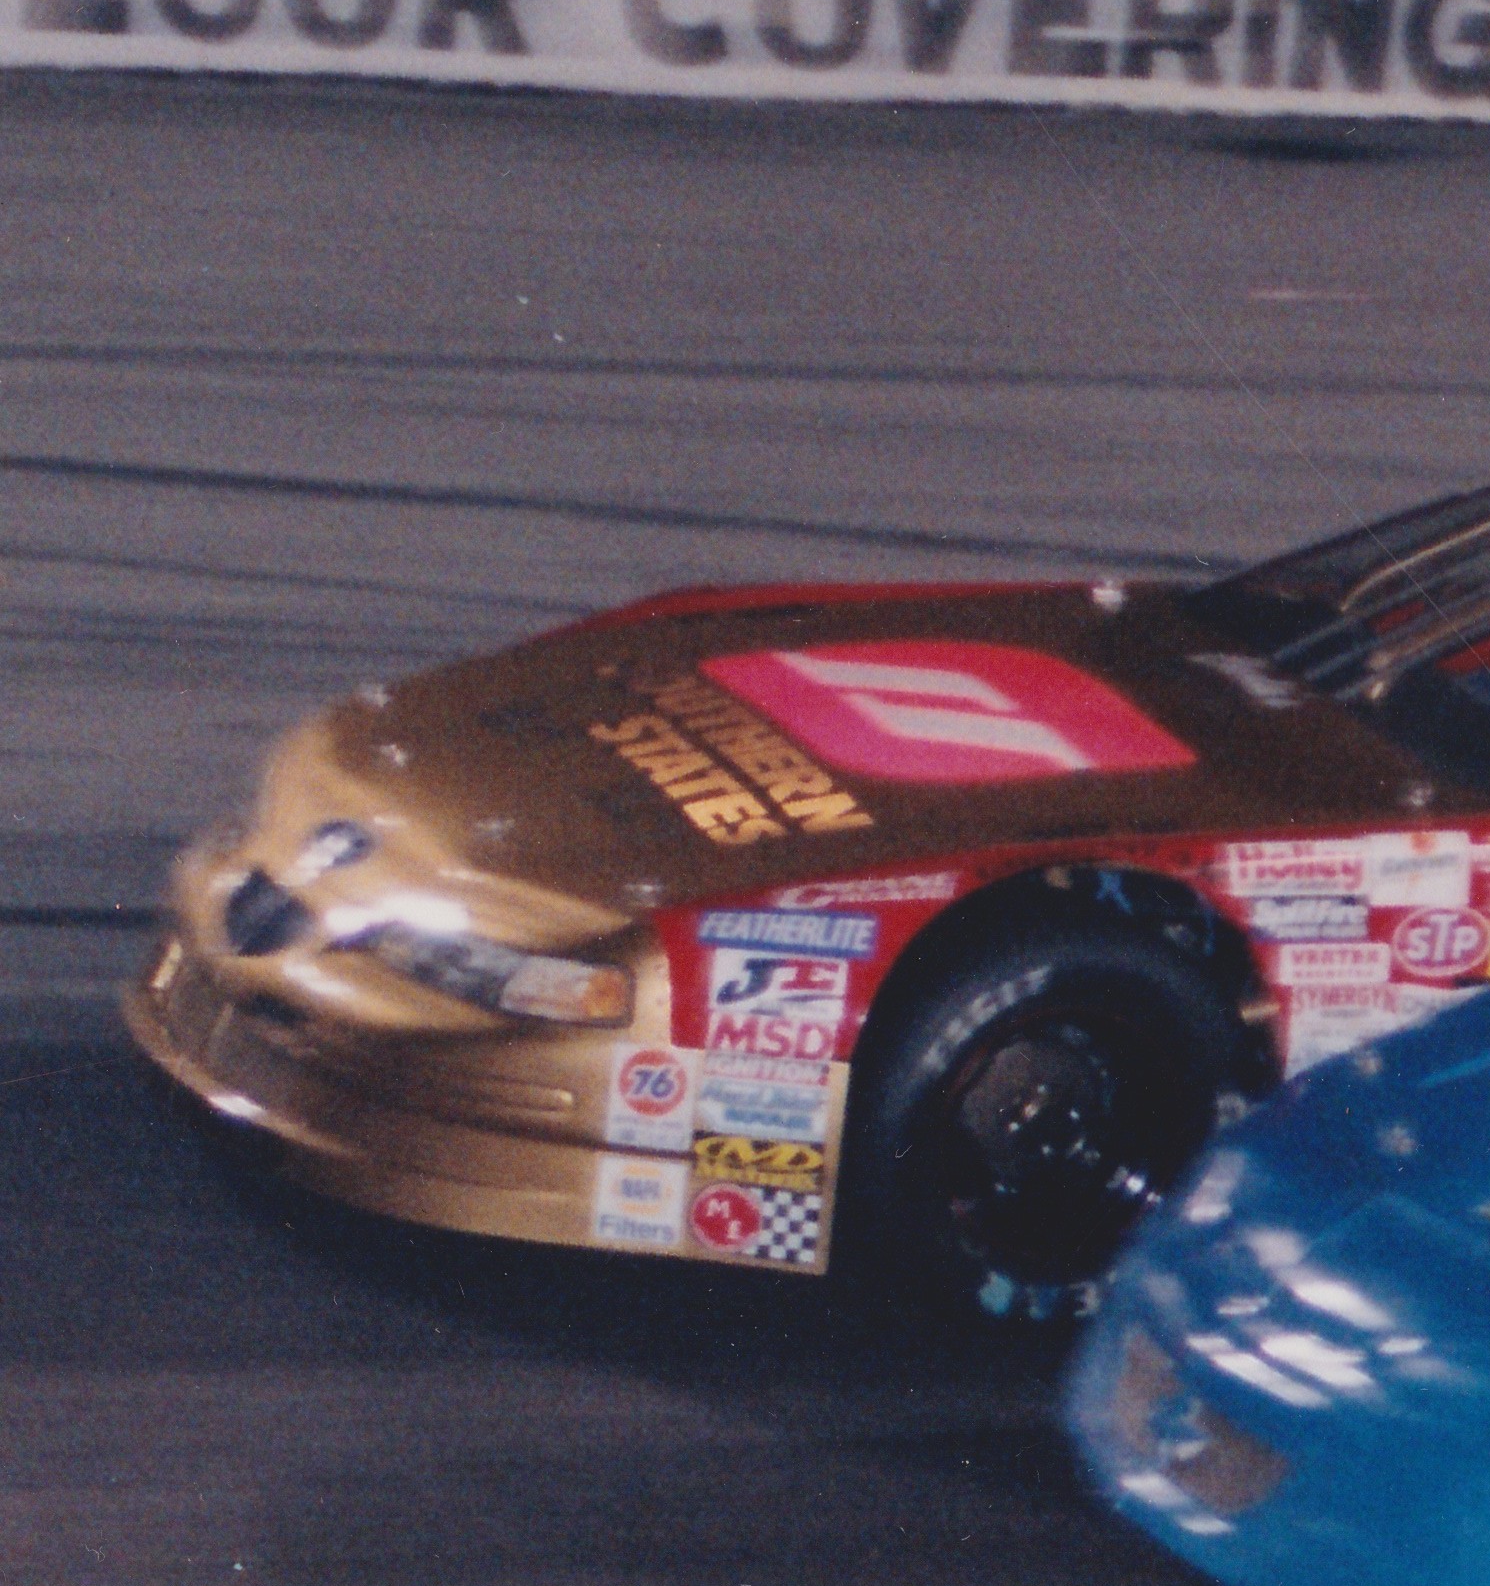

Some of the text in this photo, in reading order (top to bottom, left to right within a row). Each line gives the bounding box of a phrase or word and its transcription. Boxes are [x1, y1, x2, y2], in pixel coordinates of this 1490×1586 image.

[587, 711, 790, 845] STATES
[702, 911, 878, 952] FEATHERLITE
[1405, 913, 1484, 964] STP
[710, 1015, 837, 1061] MSD
[628, 1066, 677, 1100] 76
[597, 1211, 676, 1244] Filters
